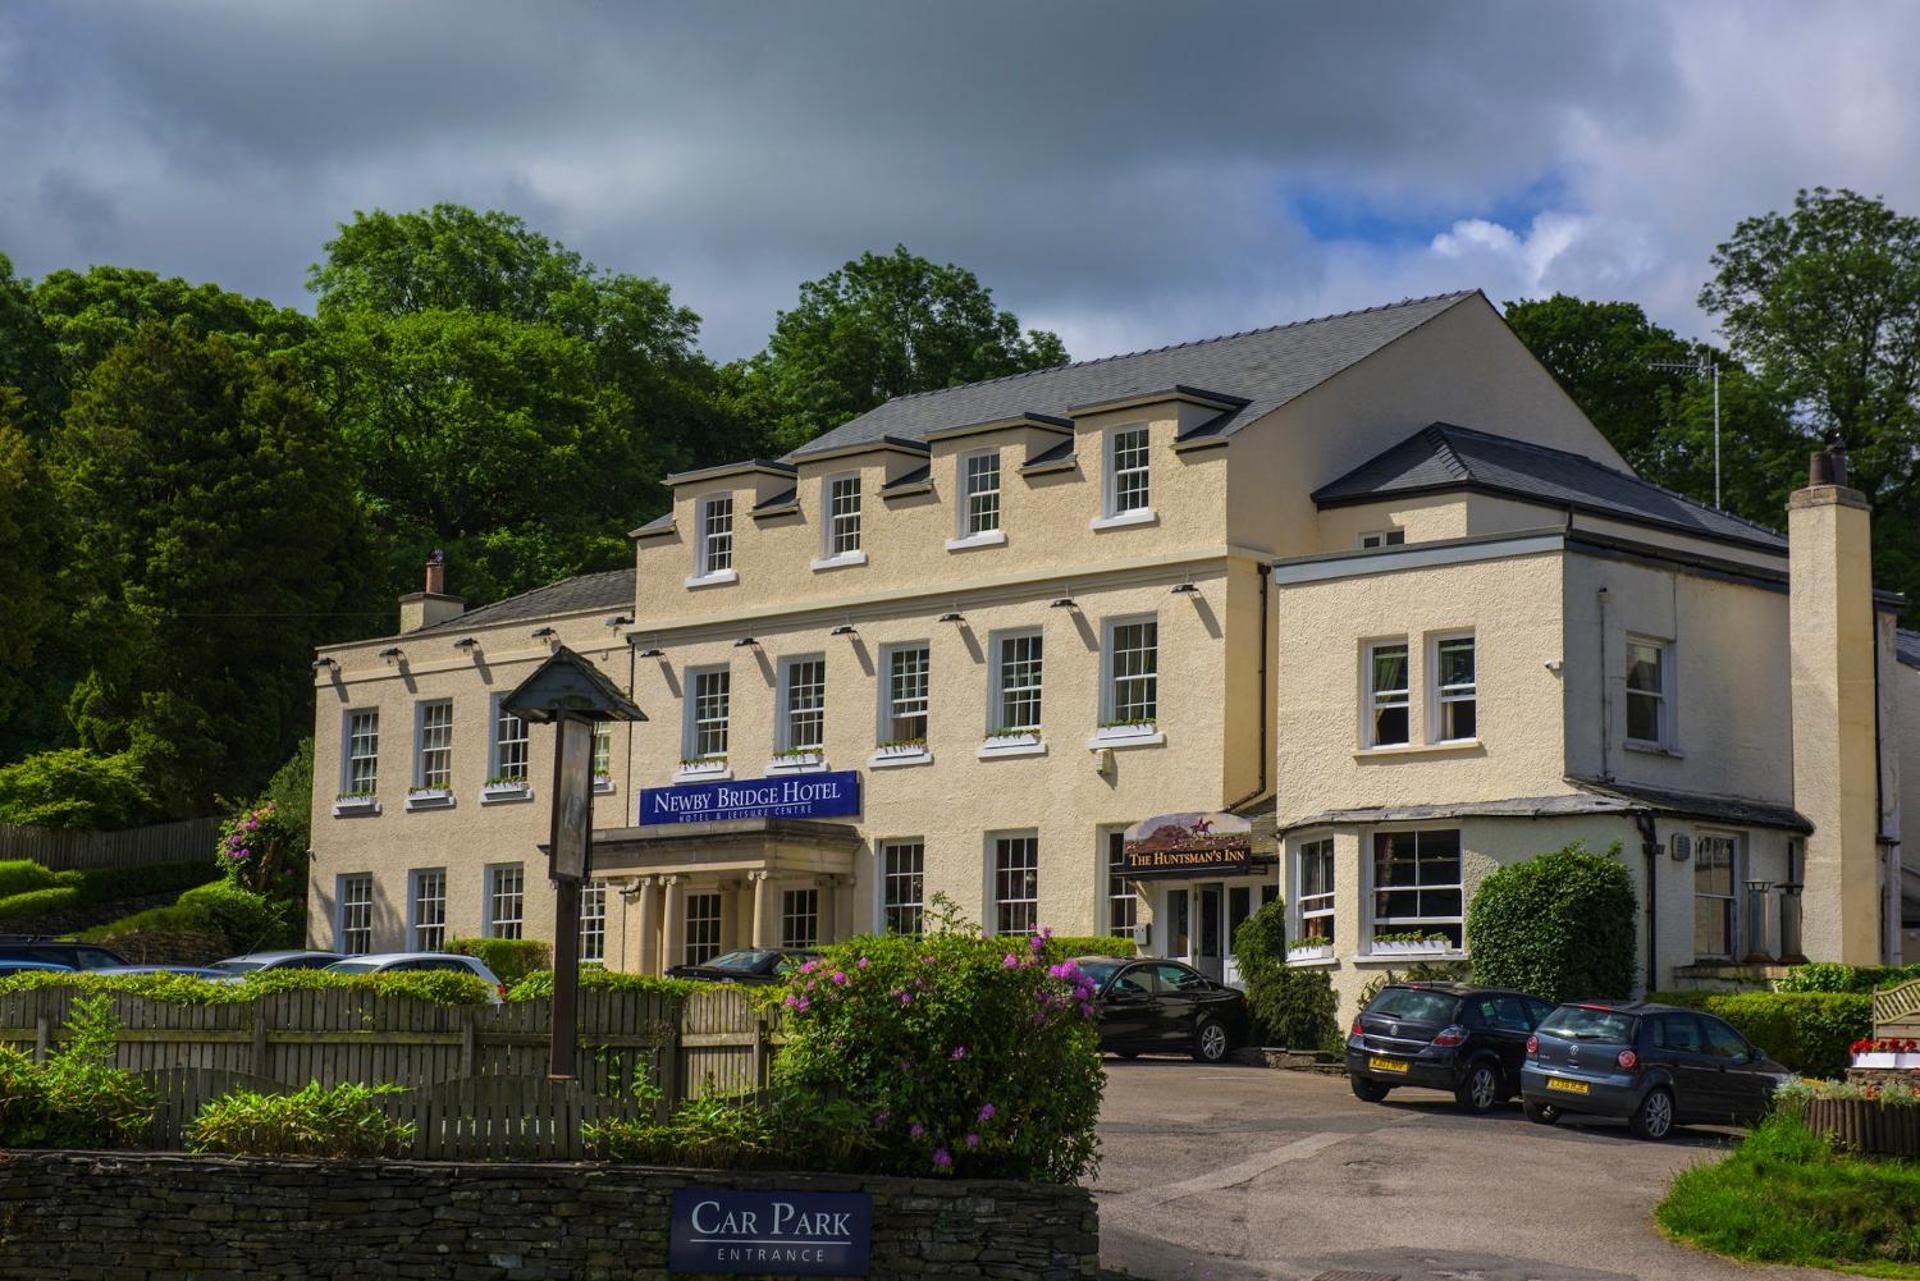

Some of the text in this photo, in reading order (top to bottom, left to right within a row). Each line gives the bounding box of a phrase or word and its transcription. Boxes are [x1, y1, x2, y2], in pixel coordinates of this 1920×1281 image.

[654, 780, 842, 813] NEWBY BRIDGE HOTEL
[679, 812, 709, 823] HOTEL
[727, 808, 769, 819] LEISURE
[775, 805, 813, 816] CENTRE
[1130, 849, 1245, 866] THE HUNTSMAN'S INN
[691, 1200, 851, 1236] CAR PARK
[717, 1248, 824, 1262] ENTRANCE
